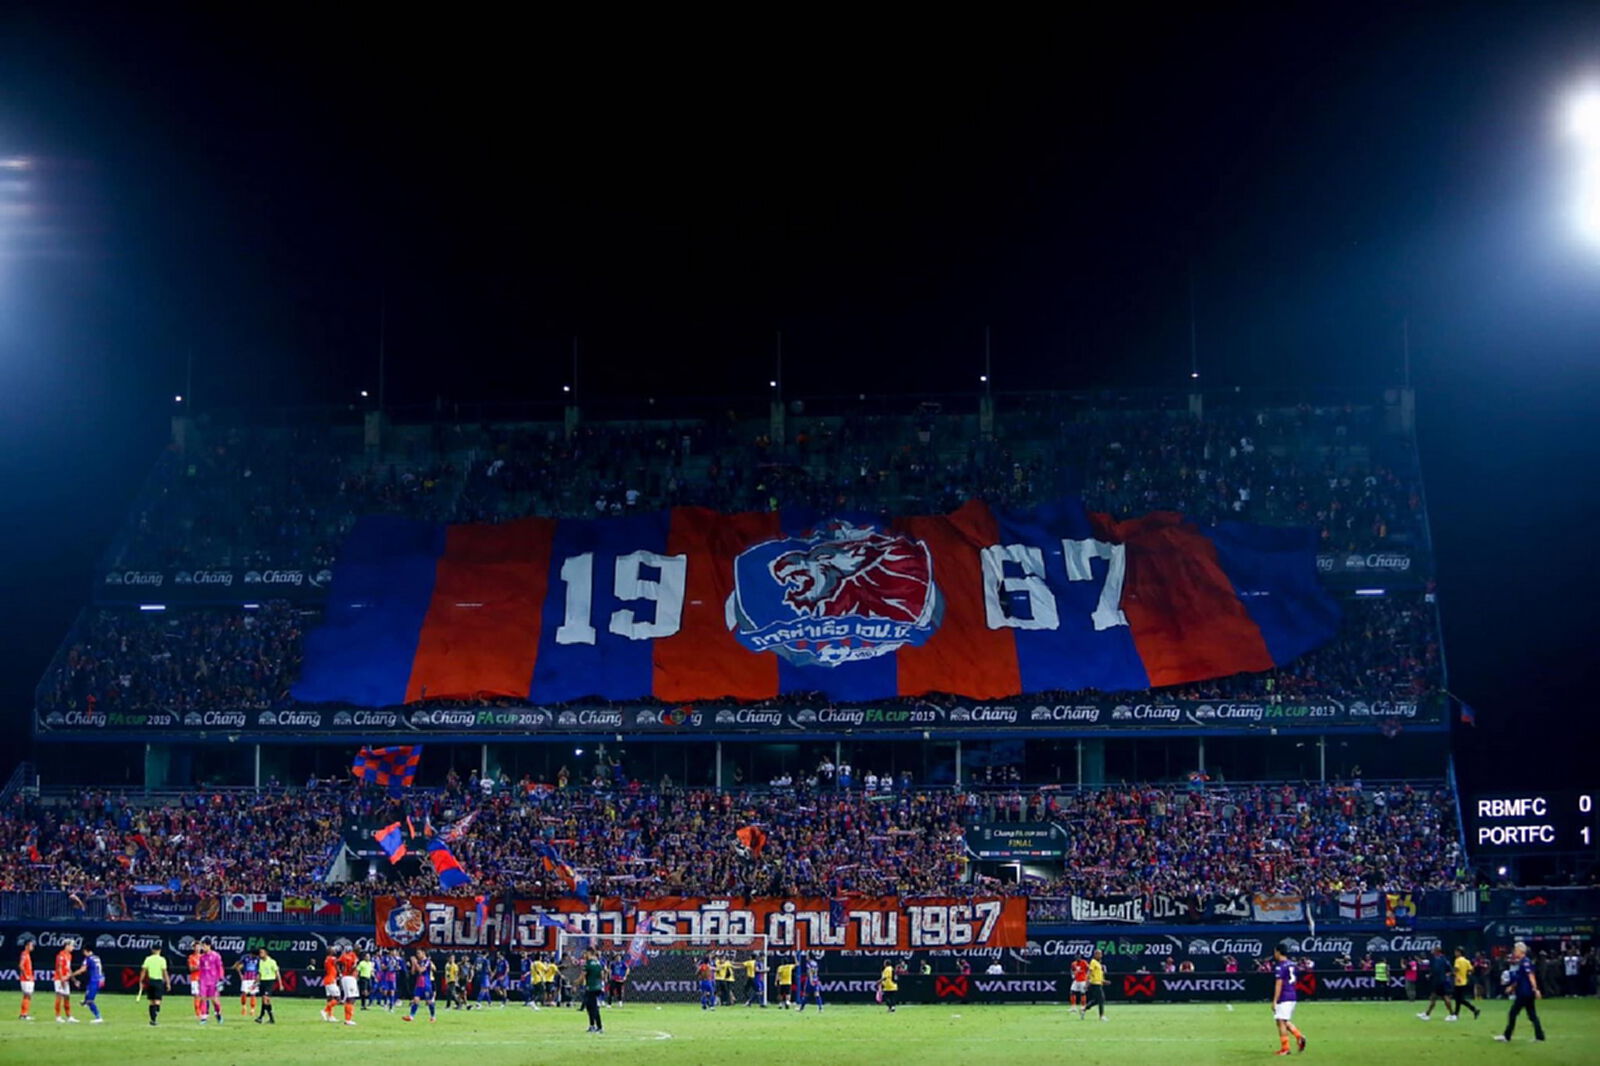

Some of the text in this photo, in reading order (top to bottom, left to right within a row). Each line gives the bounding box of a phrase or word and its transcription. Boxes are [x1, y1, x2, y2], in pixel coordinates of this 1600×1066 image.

[1366, 554, 1410, 570] Chang
[124, 571, 163, 585] Chang
[193, 571, 233, 586] Chang
[263, 570, 303, 586] Chang
[556, 538, 1130, 645] 19 67
[65, 711, 171, 726] Chang FA CUP 2019
[204, 711, 246, 727] Chang
[278, 711, 321, 727] Chang
[353, 711, 397, 727] Chang
[431, 710, 544, 727] Chang FA CUP 2019
[579, 710, 623, 727] Chang
[736, 709, 782, 726] Chang
[818, 708, 935, 725] Chang FA CUP 2019
[971, 706, 1017, 723] Chang
[1053, 705, 1099, 722] Chang
[1134, 704, 1180, 721] Chang
[1217, 704, 1335, 721] Chang FA CUP 2019
[1478, 795, 1591, 817] RBMFC 0
[1479, 825, 1590, 845] PORTFC 1
[1071, 896, 1143, 921] HELLGATE
[908, 901, 1001, 946] 1967
[38, 932, 83, 950] Chag
[247, 937, 265, 950] FA
[267, 938, 291, 951] CUP
[291, 940, 318, 952] 2019
[1043, 940, 1173, 957] Chang FA CUP 2019
[1212, 938, 1262, 956] Chang
[1301, 936, 1353, 954] Chang
[632, 980, 699, 992] WARRI
[819, 980, 876, 992] WARR
[975, 980, 1057, 992] WARRIX
[1162, 979, 1245, 991] WARRIX
